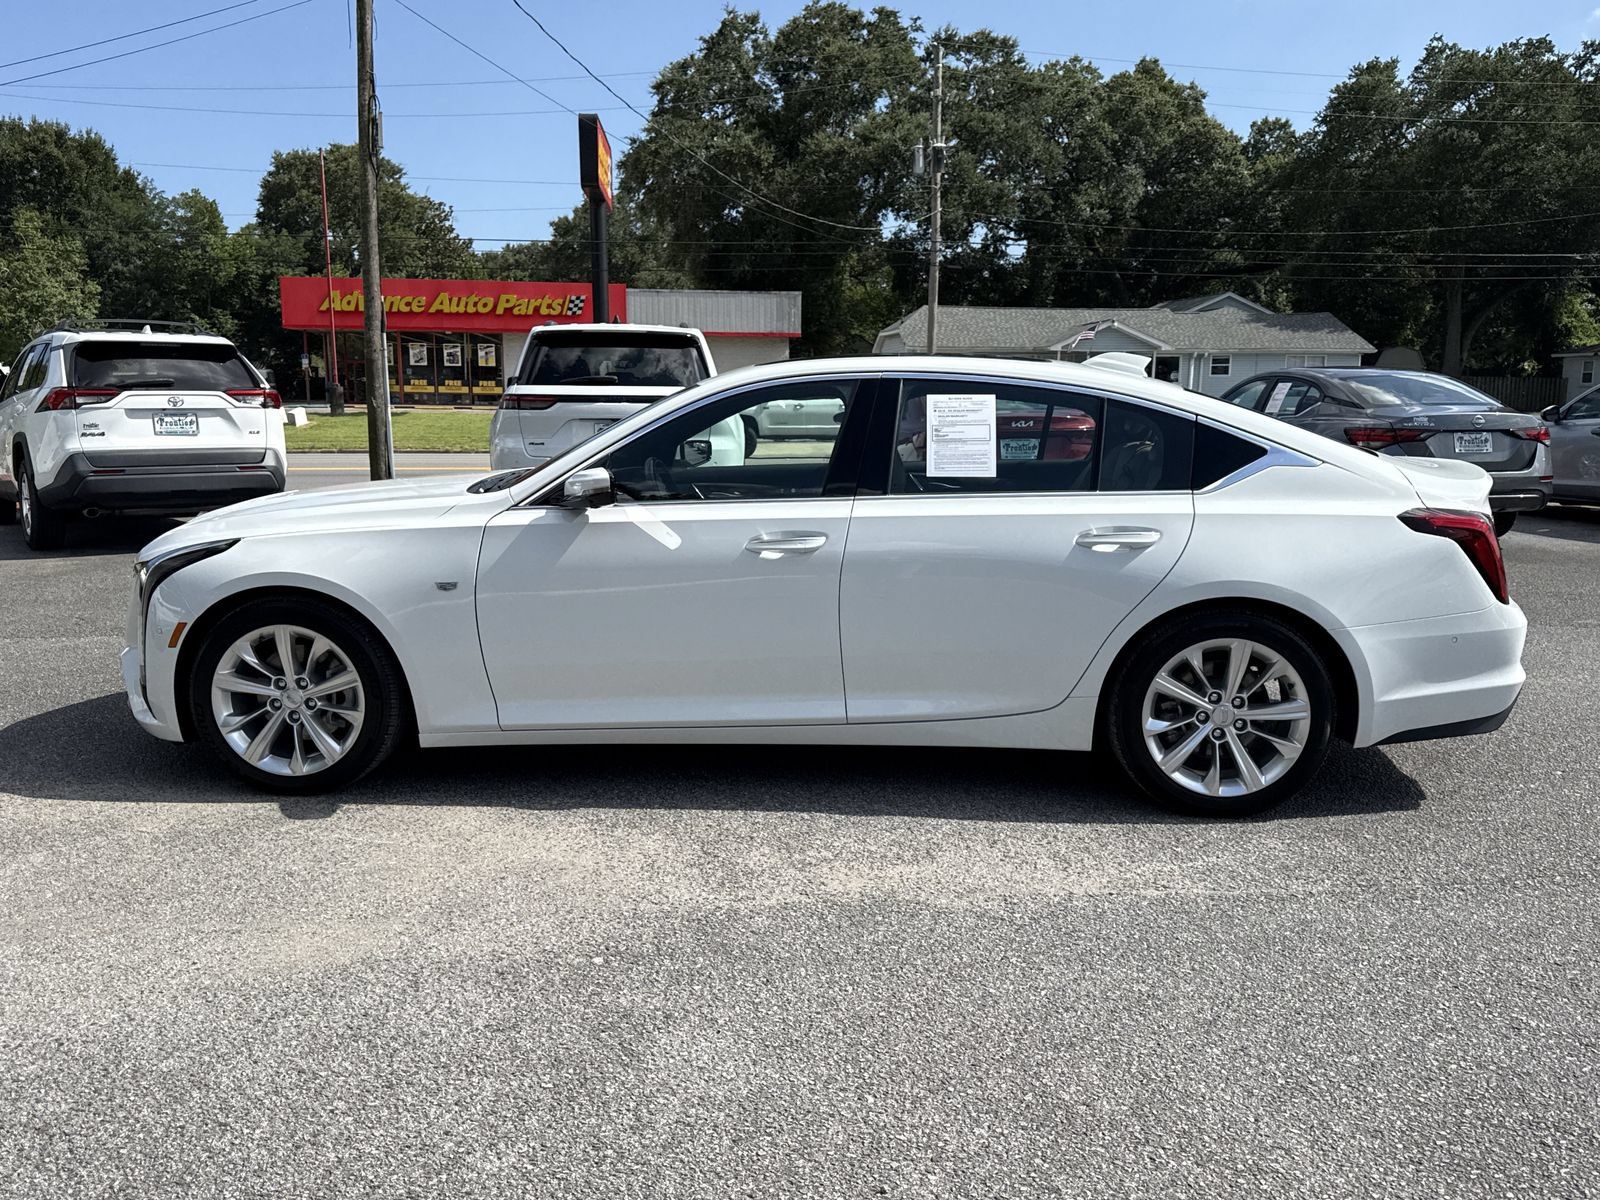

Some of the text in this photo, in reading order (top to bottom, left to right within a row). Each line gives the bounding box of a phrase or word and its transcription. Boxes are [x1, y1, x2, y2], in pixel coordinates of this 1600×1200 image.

[319, 290, 564, 316] Advnce Auto Parts
